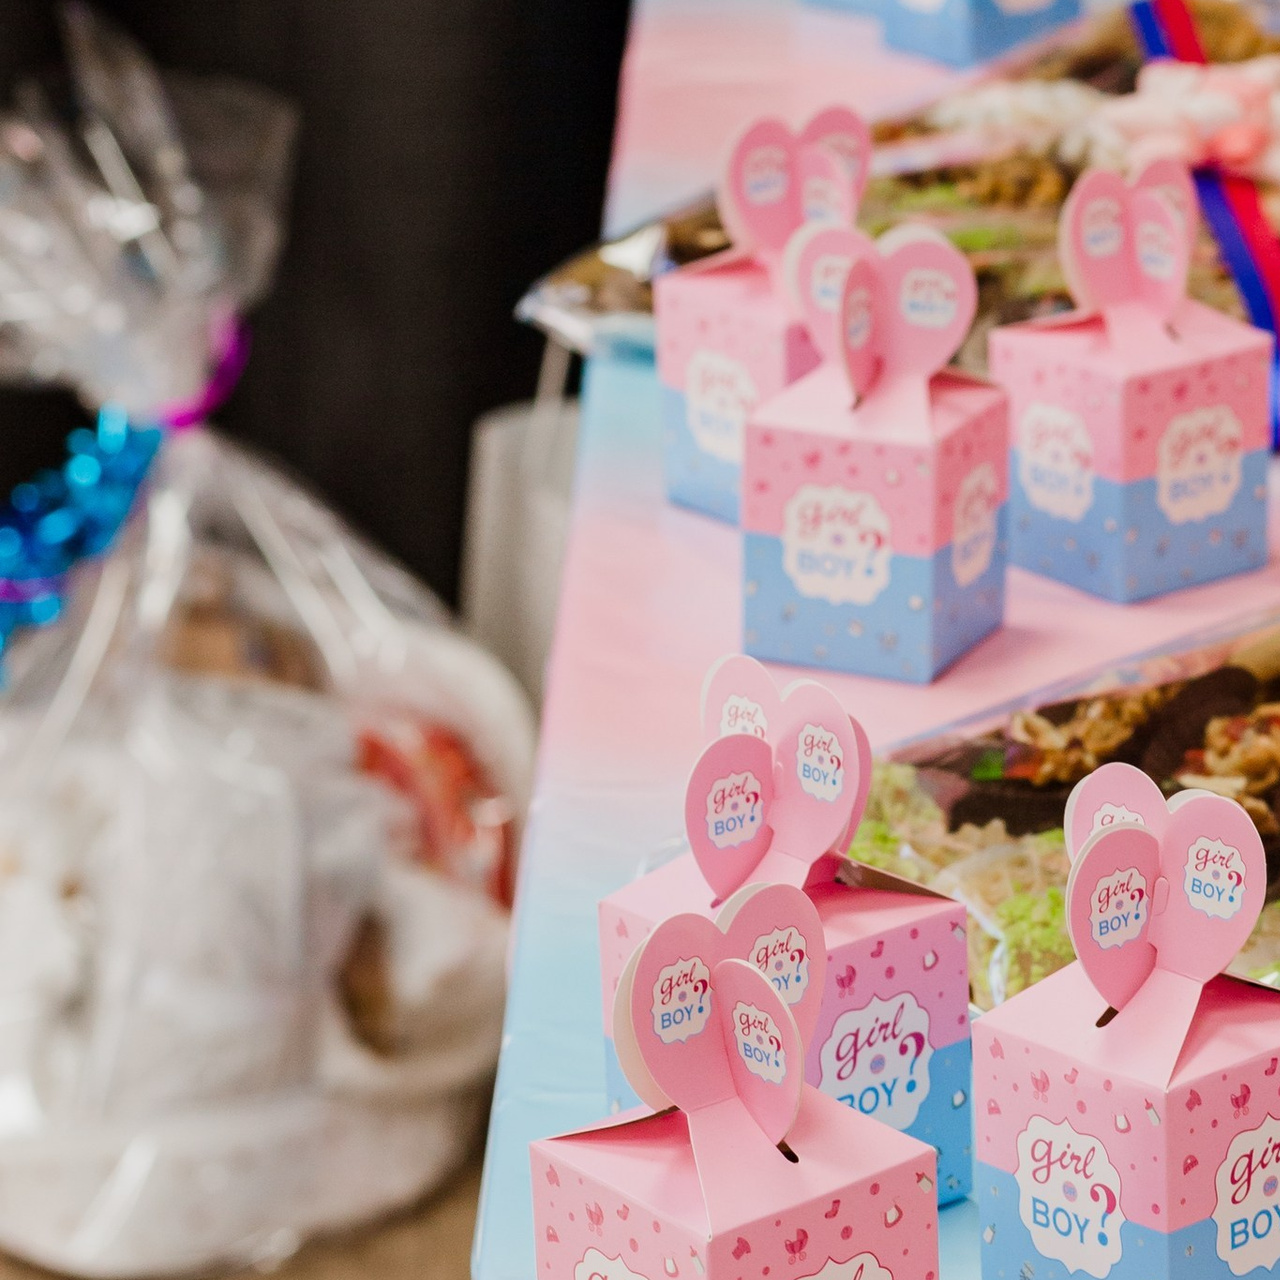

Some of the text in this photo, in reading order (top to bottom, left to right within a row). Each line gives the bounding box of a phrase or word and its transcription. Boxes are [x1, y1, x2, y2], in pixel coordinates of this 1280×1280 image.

[728, 705, 758, 728] girl
[804, 734, 833, 757] girl
[713, 776, 748, 814] girl
[1195, 847, 1234, 871] girl
[1098, 873, 1133, 913] girl
[756, 931, 793, 971] girl
[660, 962, 696, 1005] girl
[739, 1012, 769, 1036] girl
[835, 1002, 904, 1081] girl
[1031, 1138, 1096, 1184] girl
